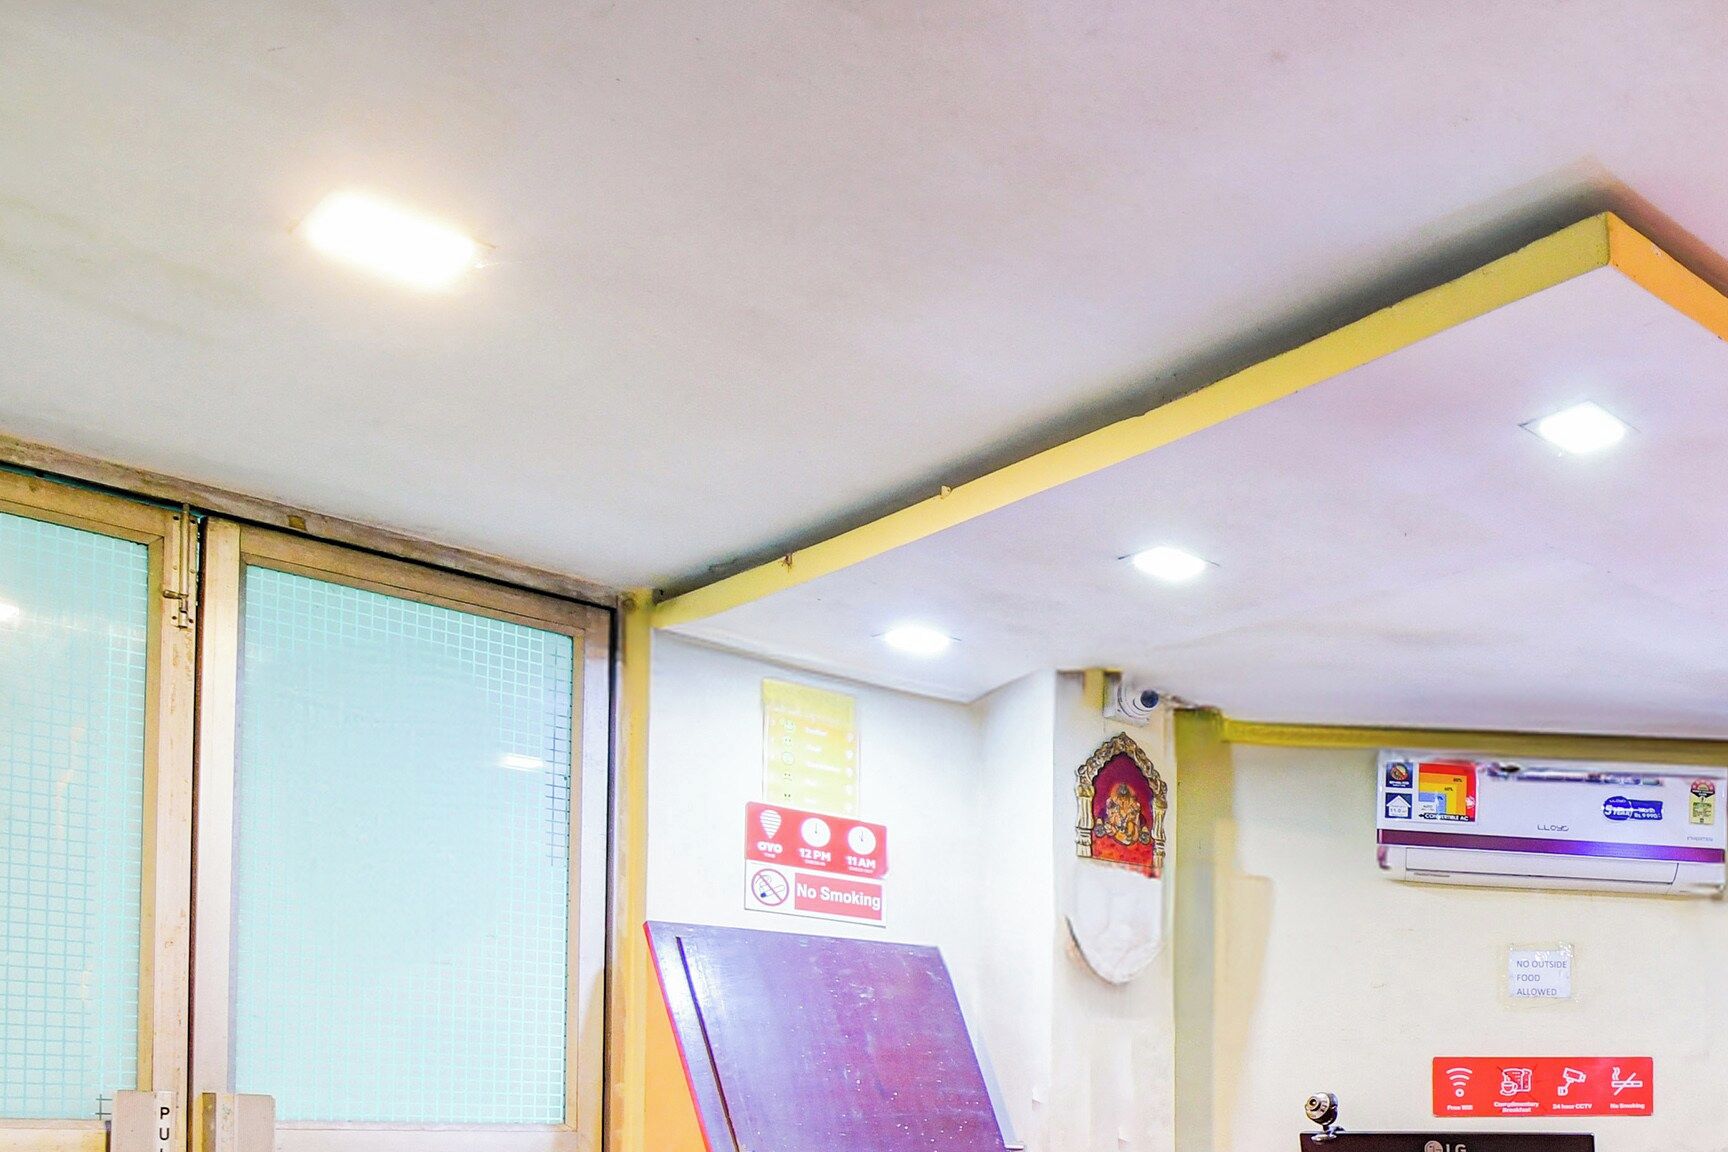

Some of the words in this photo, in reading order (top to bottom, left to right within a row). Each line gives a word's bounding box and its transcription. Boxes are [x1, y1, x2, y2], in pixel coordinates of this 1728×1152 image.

[757, 841, 783, 854] OYO
[799, 847, 813, 859] 12
[814, 850, 832, 862] PM
[845, 855, 860, 866] 11
[860, 858, 876, 869] AM
[796, 883, 817, 898] No
[820, 886, 881, 911] Smoking
[1516, 960, 1530, 968] NO
[1531, 960, 1568, 968] OUTSIDE
[1516, 974, 1541, 982] FOOD
[1516, 988, 1558, 996] ALLOWED
